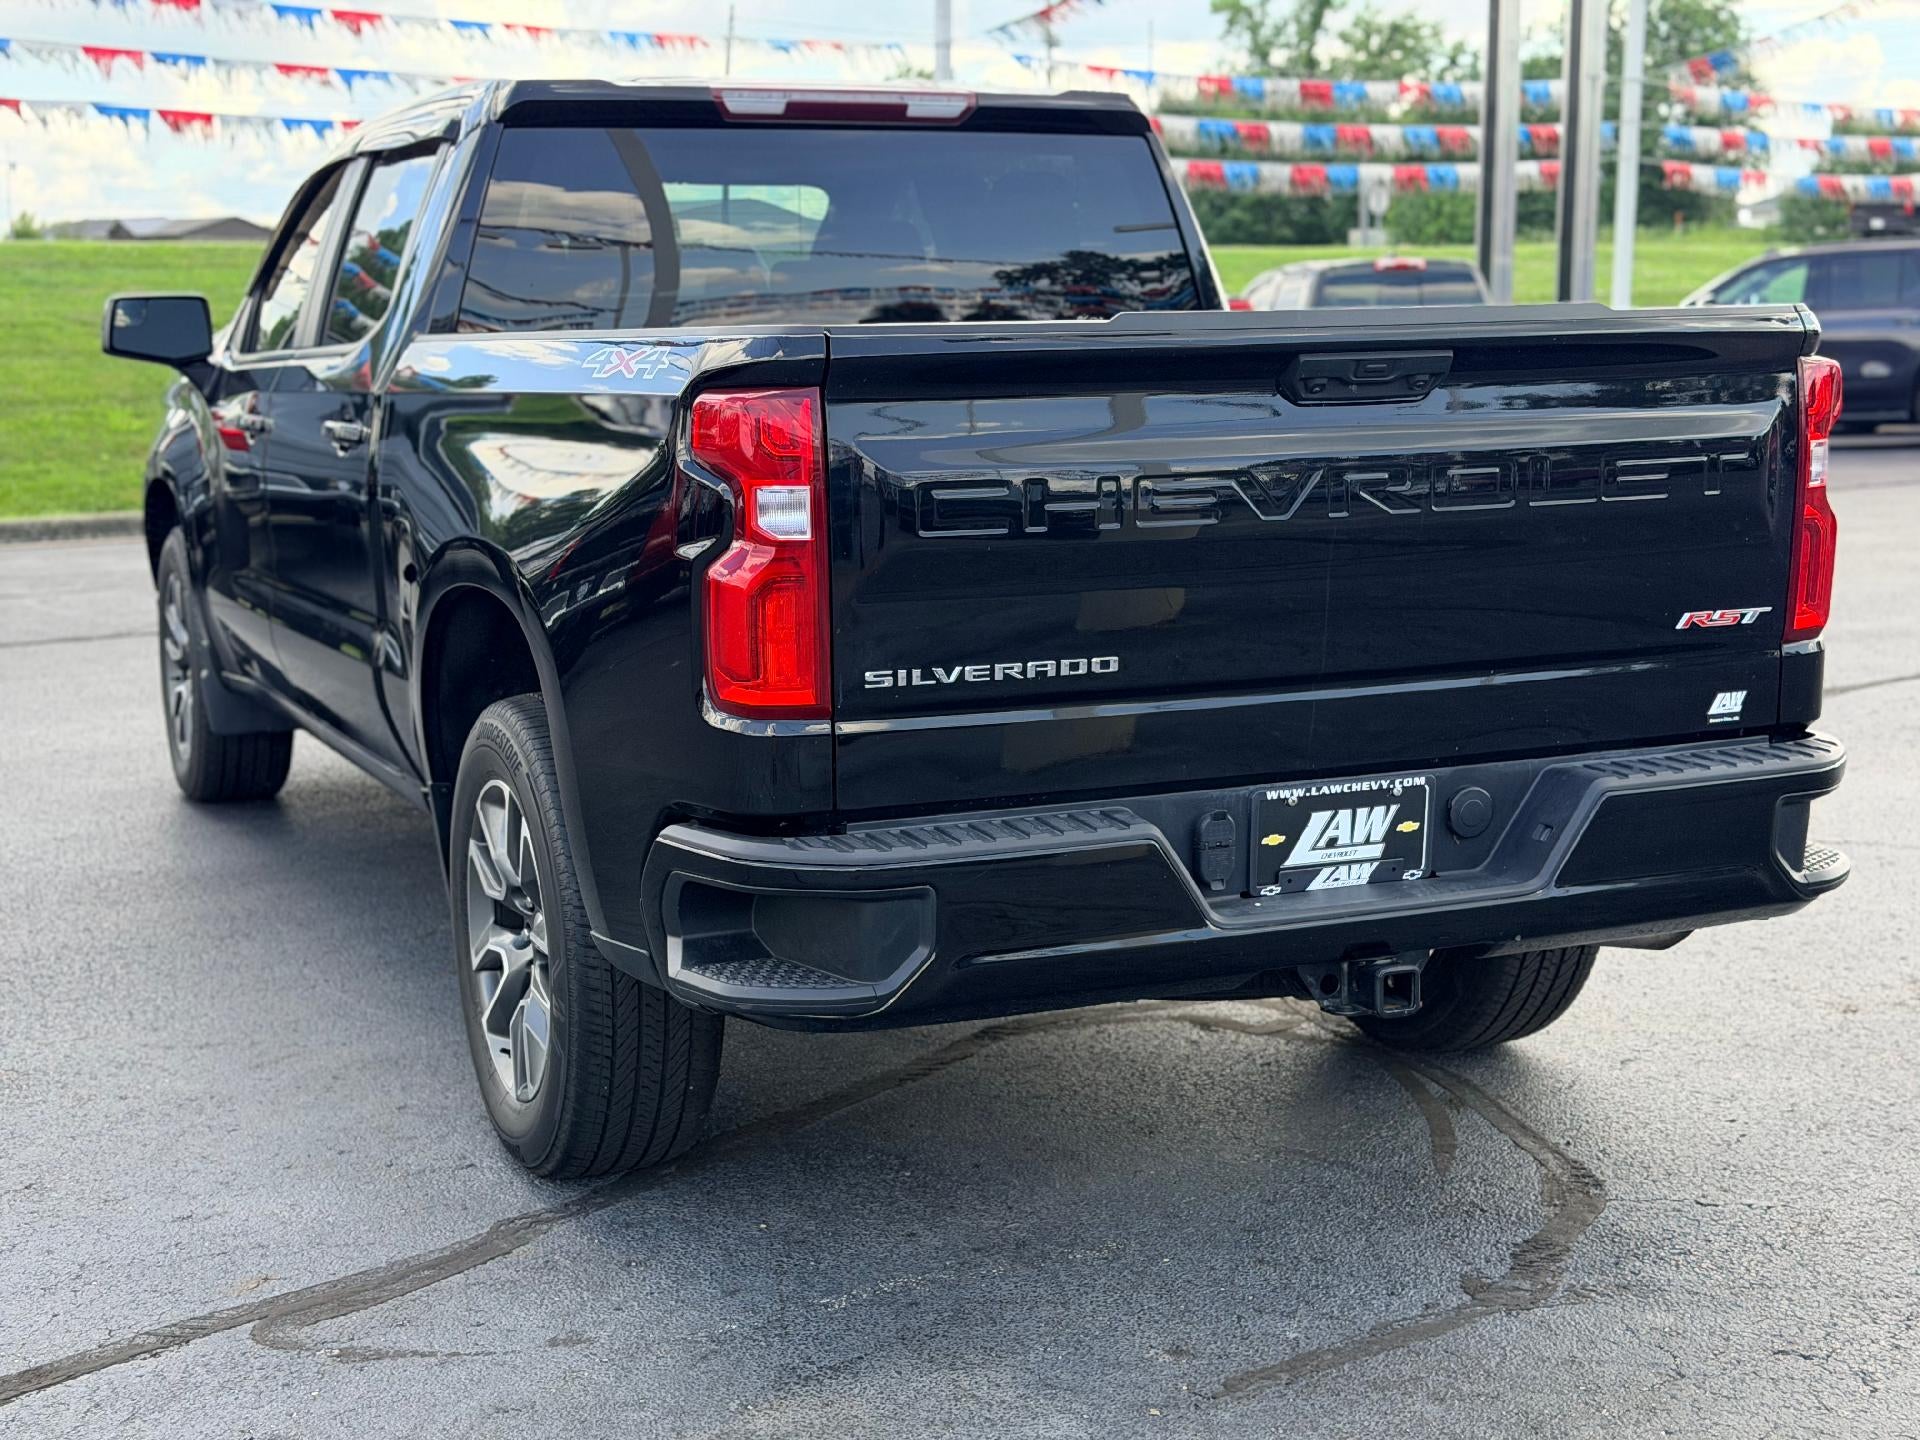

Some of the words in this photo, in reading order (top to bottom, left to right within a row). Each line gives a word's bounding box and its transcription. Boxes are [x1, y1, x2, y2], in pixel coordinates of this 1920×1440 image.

[915, 449, 1750, 539] CHEVROLET
[1675, 606, 1773, 630] RST
[864, 656, 1119, 689] SILVERADO
[1707, 690, 1748, 715] LAW
[1266, 776, 1426, 801] WWW.LAWCHEVY.COM
[1280, 803, 1400, 868] LAW
[1320, 849, 1359, 860] CHEVROLET
[1305, 861, 1381, 892] LAW
